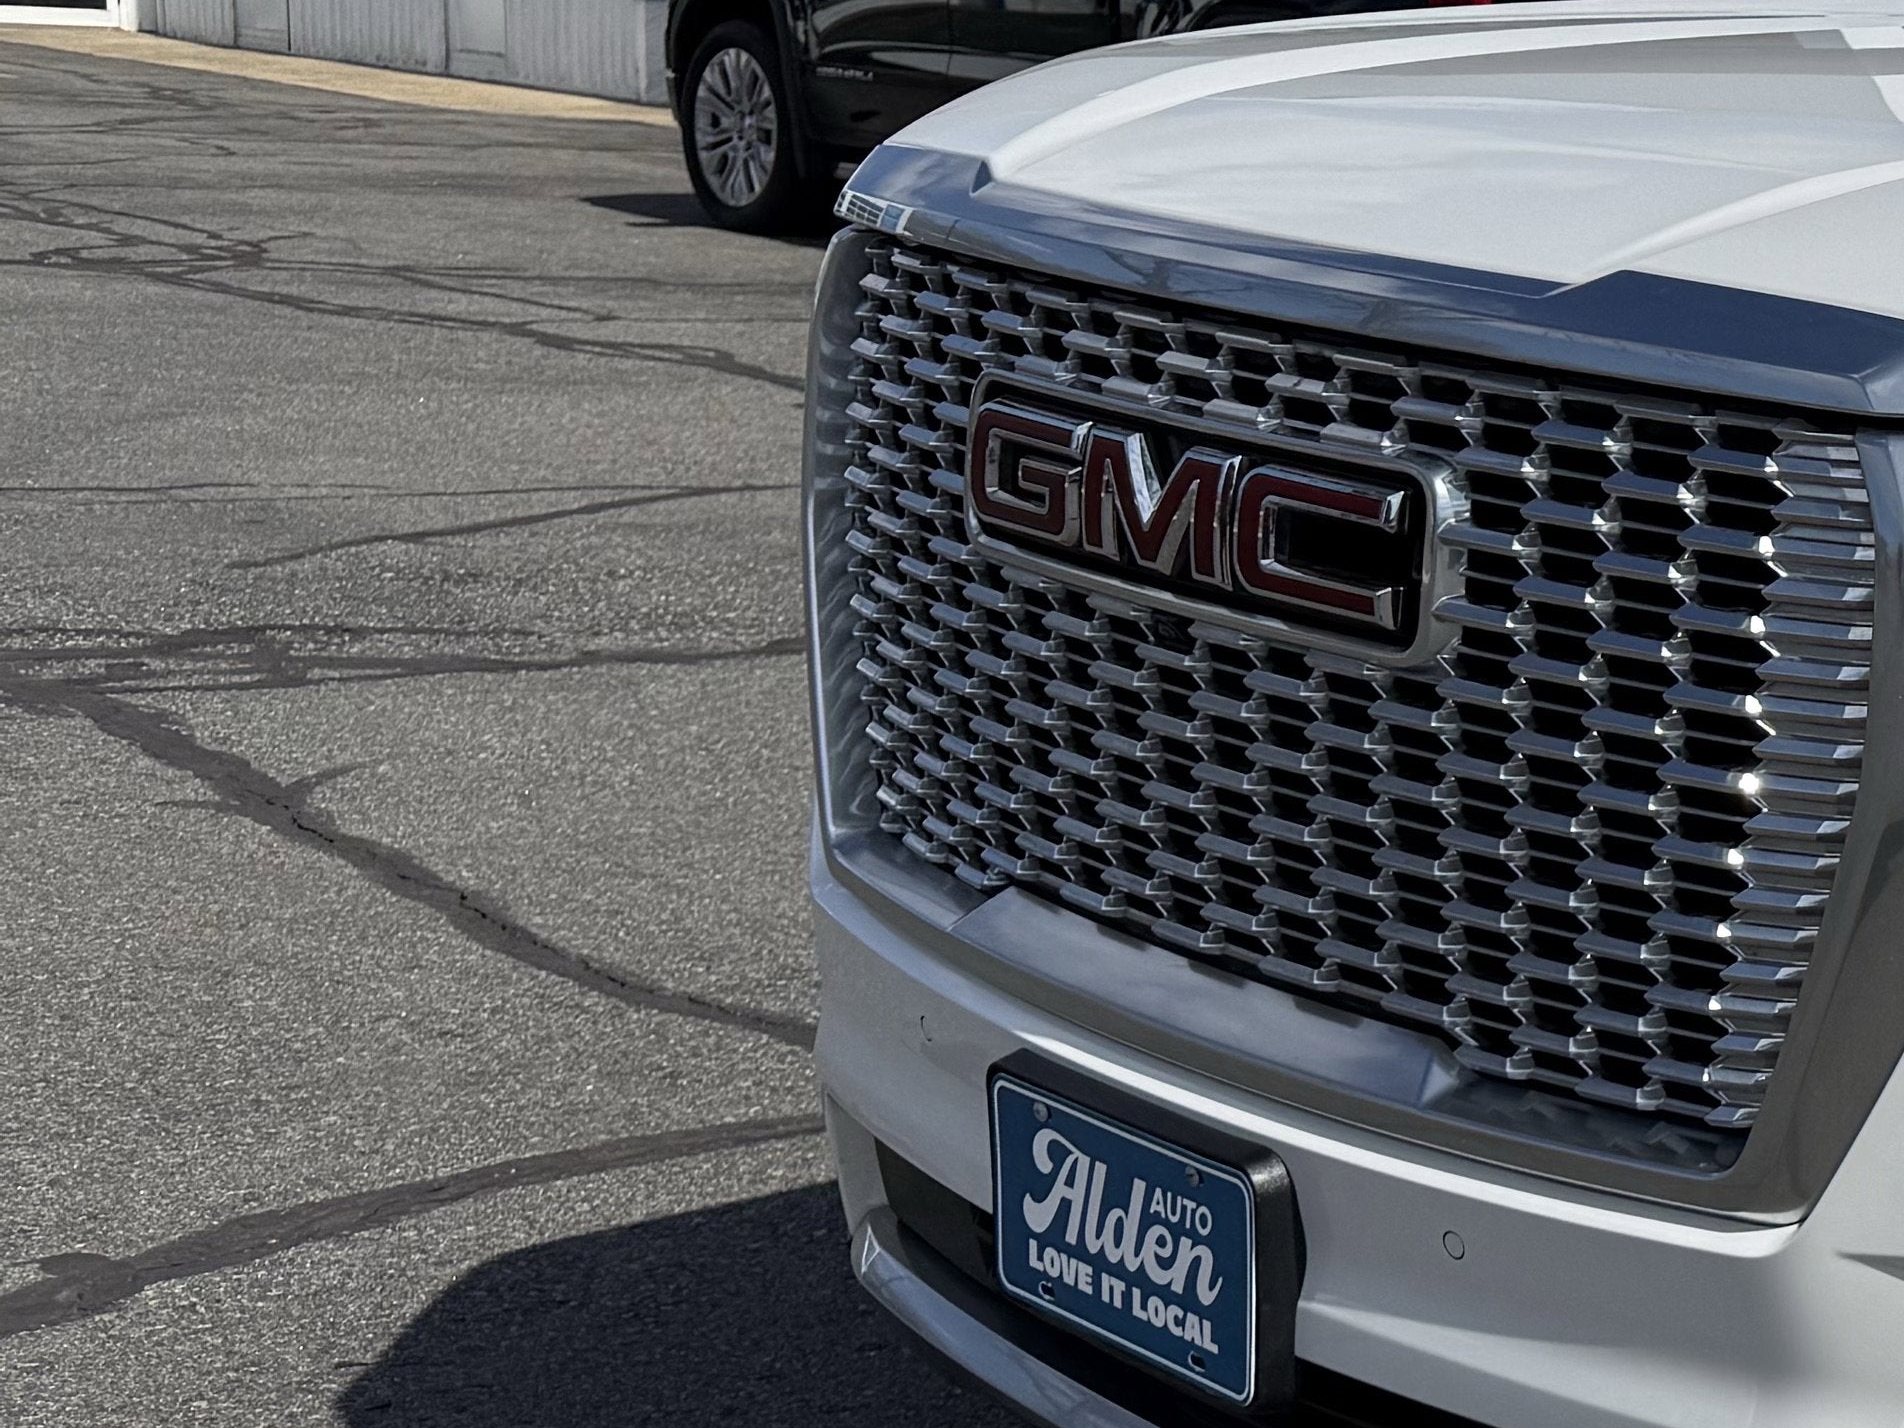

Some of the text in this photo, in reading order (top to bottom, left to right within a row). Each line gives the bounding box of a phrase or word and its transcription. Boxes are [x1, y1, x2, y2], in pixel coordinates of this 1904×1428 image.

[971, 398, 1406, 630] GMC
[1023, 1128, 1224, 1306] Alden
[1149, 1187, 1213, 1236] AUTO
[1028, 1239, 1219, 1354] LOVE IT LOCAL
